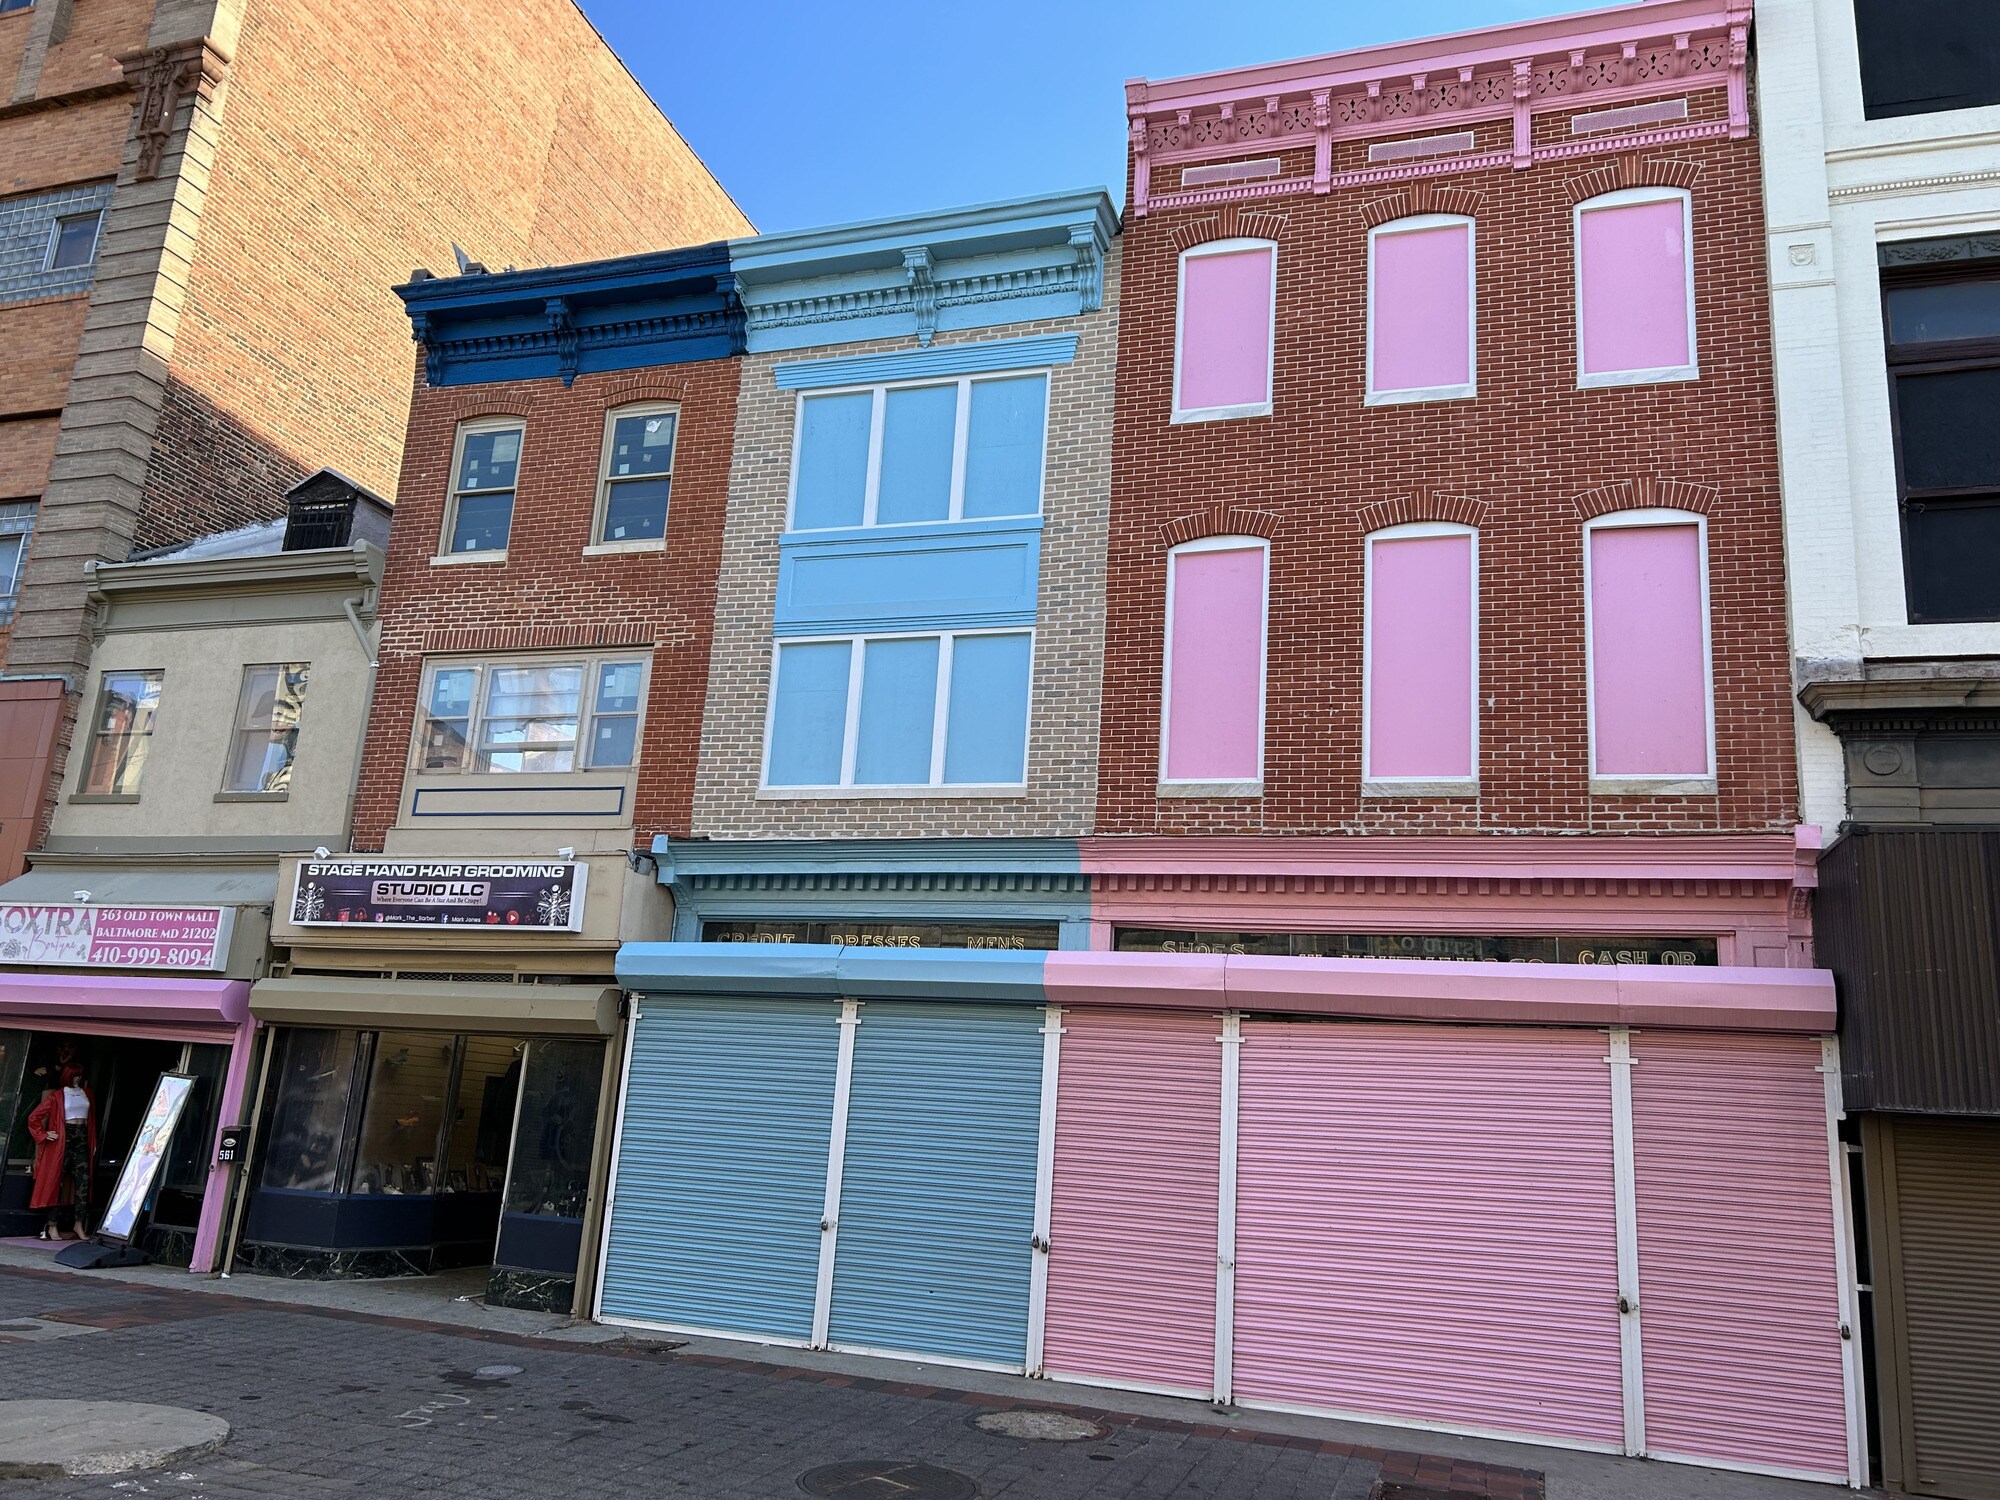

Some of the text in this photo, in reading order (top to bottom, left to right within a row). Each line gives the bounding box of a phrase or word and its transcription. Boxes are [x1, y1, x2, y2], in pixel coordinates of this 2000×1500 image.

[307, 864, 565, 878] STAGE HAND HAIR GROOMING
[376, 883, 485, 896] STUDIO LLC
[0, 907, 92, 935] OXTRA
[101, 909, 215, 922] 563 OLD TOWN MALL
[96, 927, 217, 940] BALTIMORE MD 21202
[91, 946, 213, 966] 410-999-8094
[1578, 949, 1697, 966] CASH OR
[219, 1149, 234, 1160] 561
